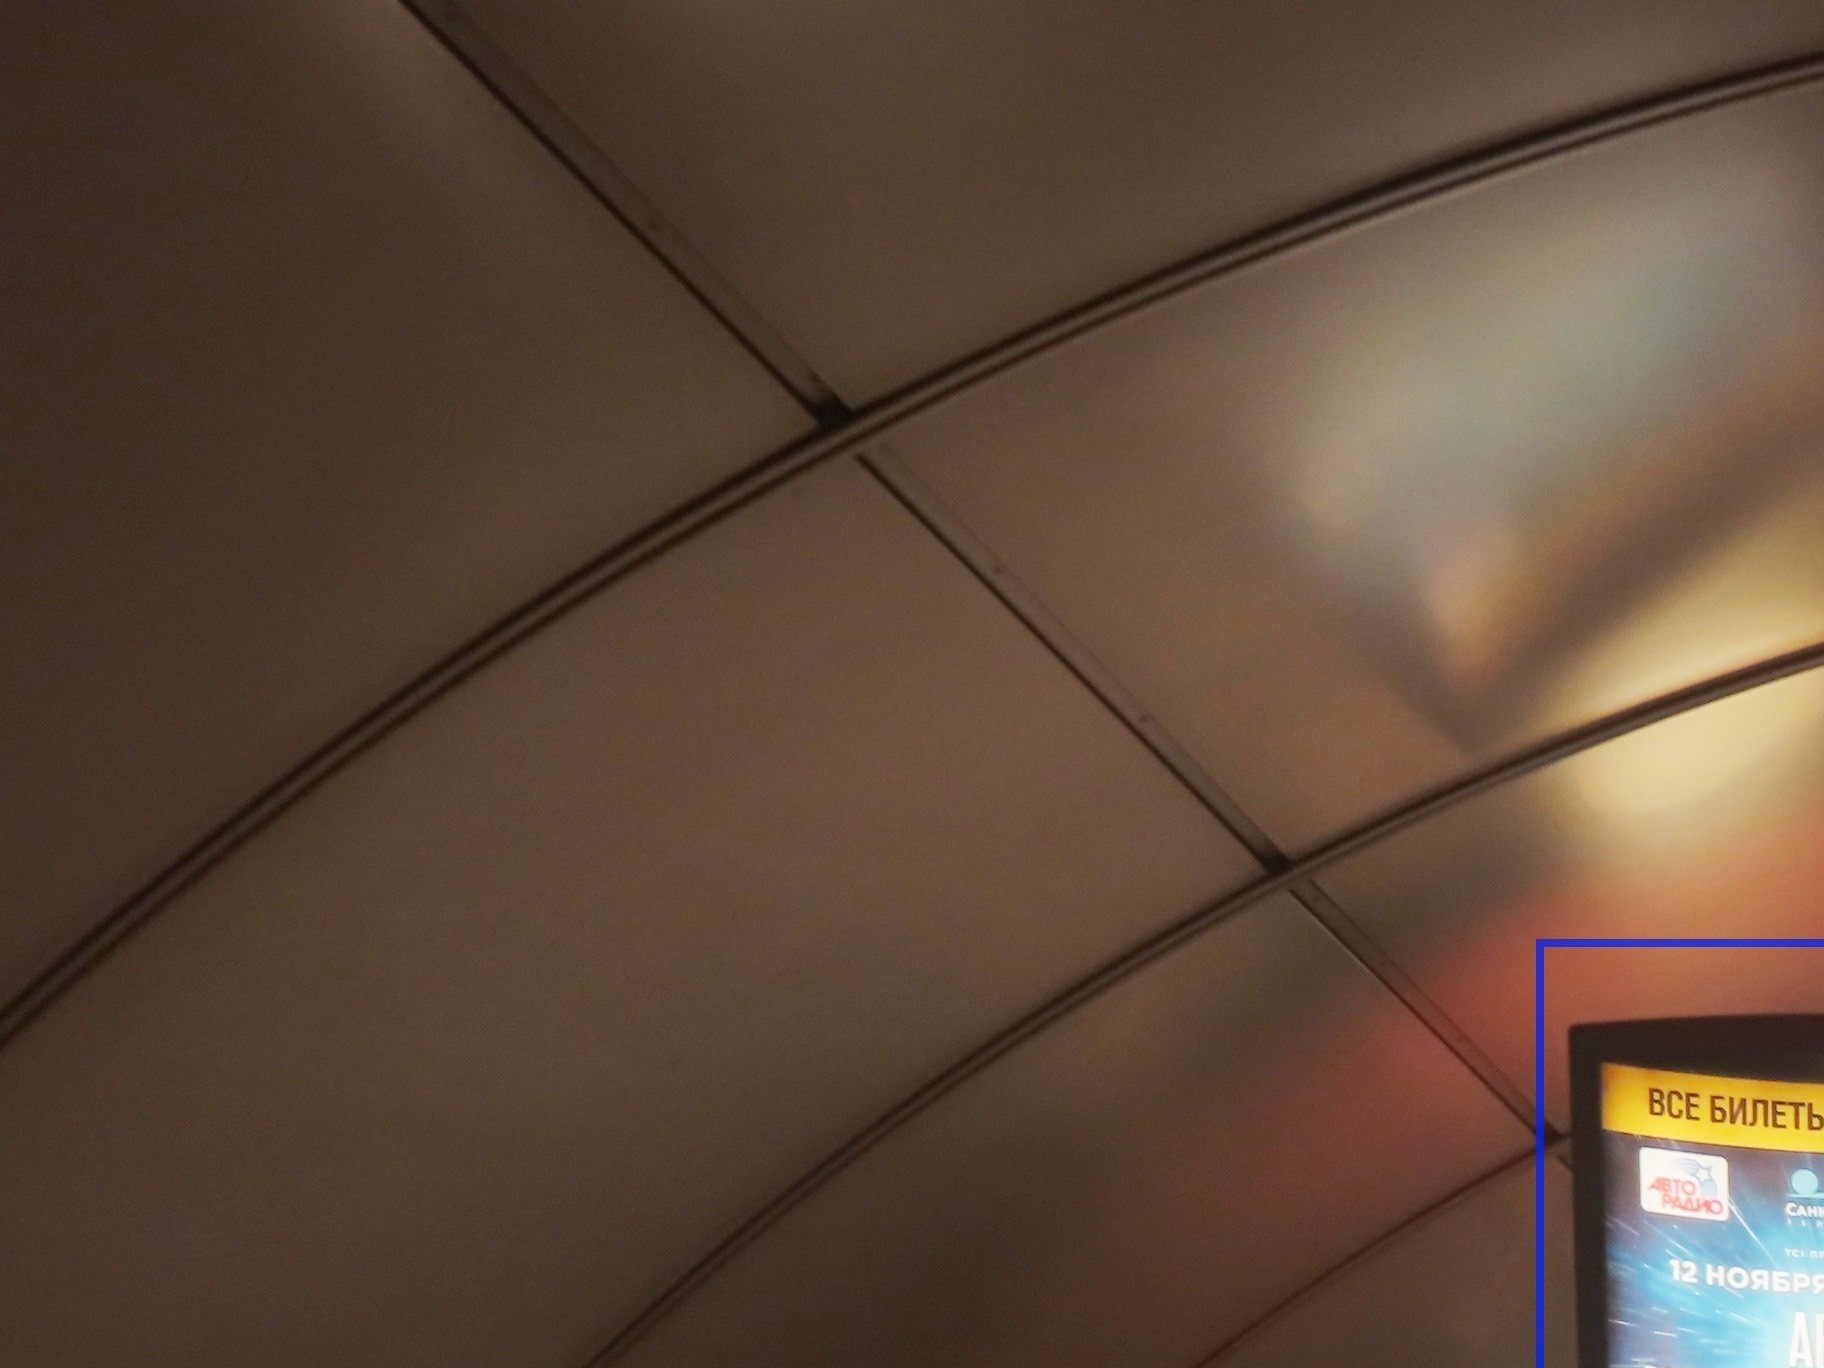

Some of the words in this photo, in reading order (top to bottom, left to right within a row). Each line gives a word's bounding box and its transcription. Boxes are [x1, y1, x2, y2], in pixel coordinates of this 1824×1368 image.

[1648, 1087, 1700, 1121] ВСЕ
[1647, 1177, 1697, 1195] АВТО
[1662, 1194, 1723, 1216] РАДИО
[1669, 1259, 1698, 1283] 12
